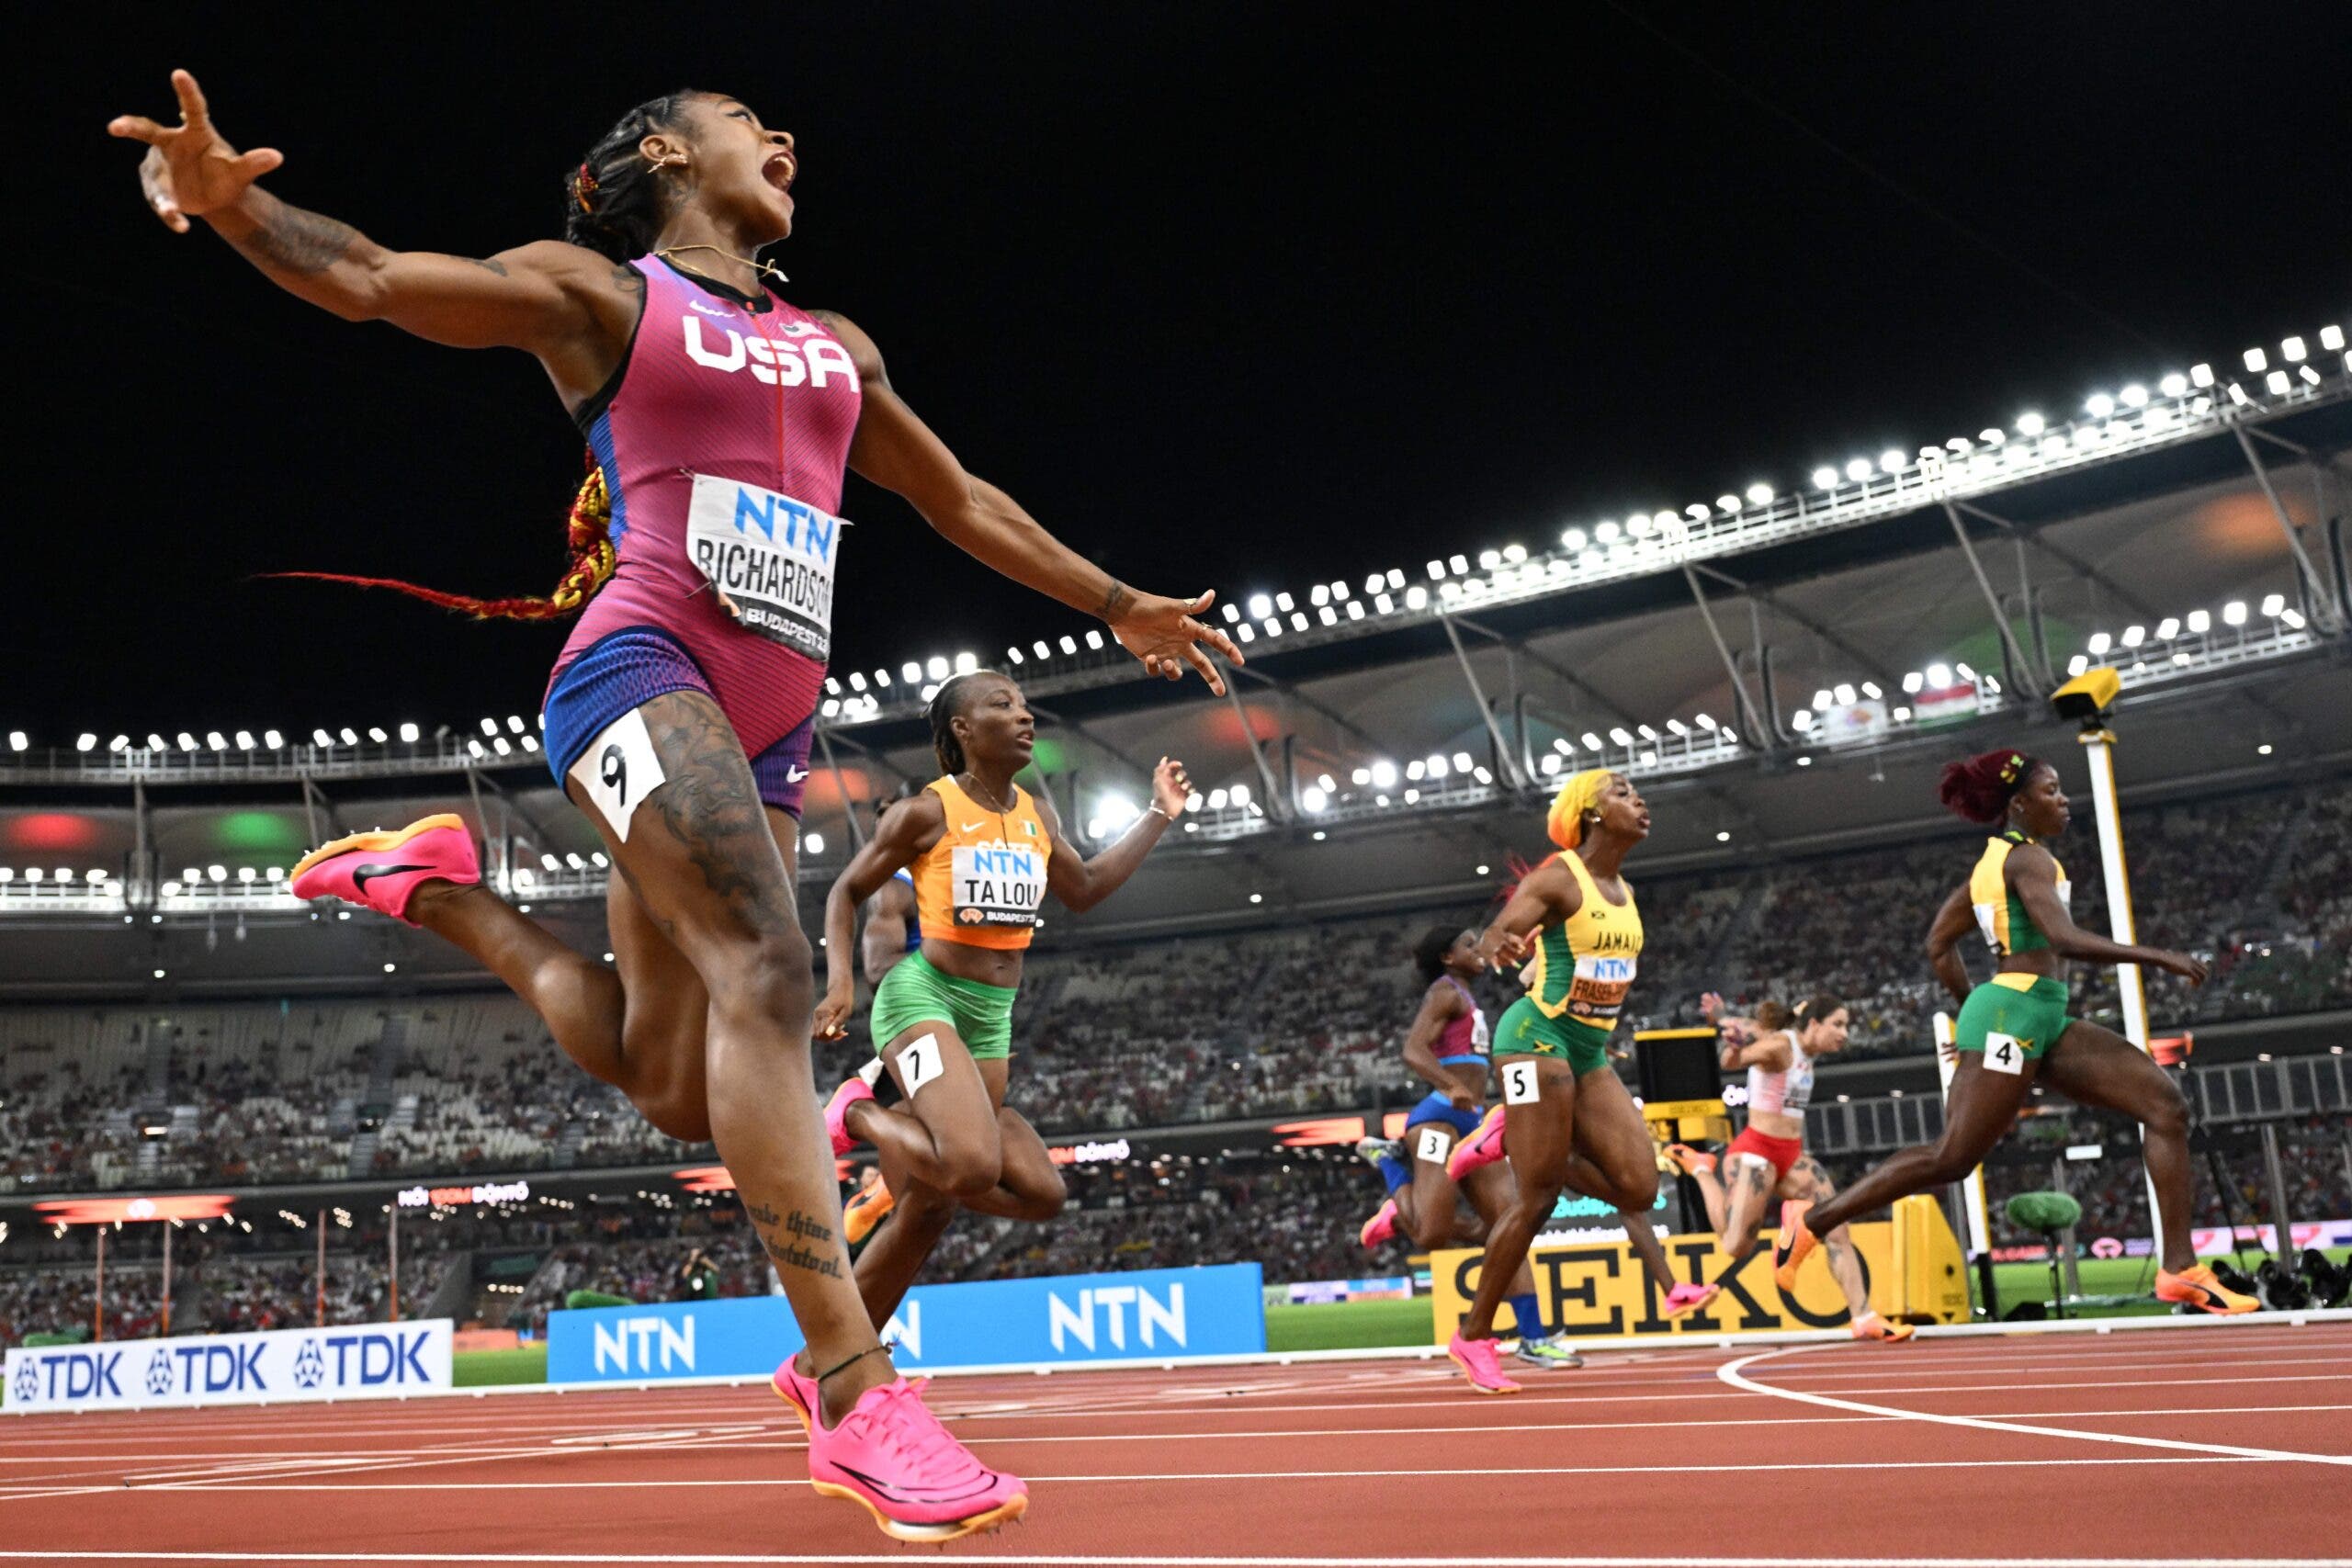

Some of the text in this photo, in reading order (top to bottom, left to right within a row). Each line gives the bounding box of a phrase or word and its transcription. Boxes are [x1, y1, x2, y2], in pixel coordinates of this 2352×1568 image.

[683, 315, 860, 394] USA
[735, 486, 834, 565] NTN
[601, 743, 627, 807] 9
[974, 850, 1032, 877] NTN
[965, 879, 1038, 907] TA LOU
[1594, 959, 1627, 980] NTN
[907, 1049, 921, 1081] 7
[1996, 1042, 2012, 1066] 4
[1513, 1069, 1525, 1097] 5
[1427, 1135, 1437, 1155] 3
[1048, 1281, 1187, 1353] NTN
[175, 1342, 268, 1393] TDK
[326, 1331, 431, 1386] TDK
[594, 1314, 695, 1374] NTN
[41, 1351, 123, 1400] TDK
